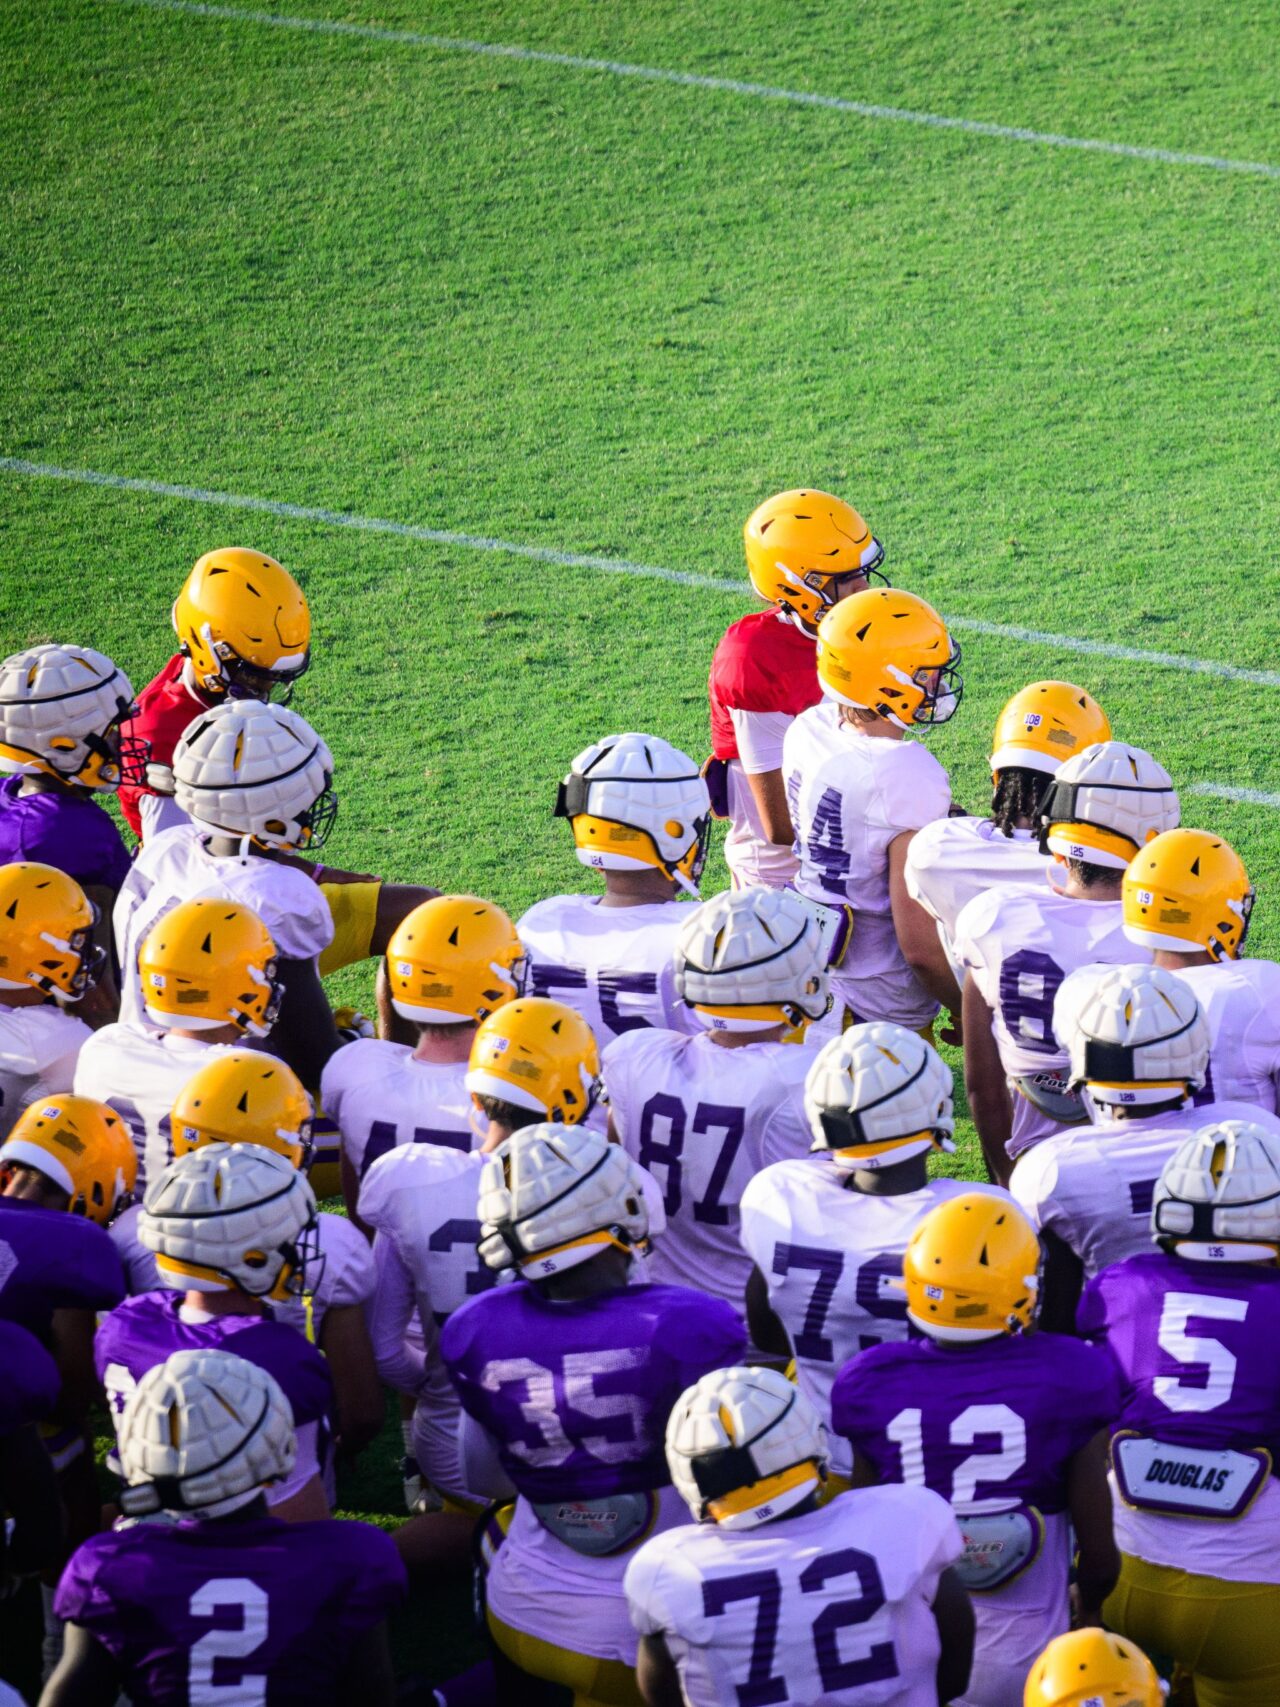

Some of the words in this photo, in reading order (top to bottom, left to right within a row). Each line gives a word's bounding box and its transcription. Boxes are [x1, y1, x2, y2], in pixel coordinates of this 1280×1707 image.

[1026, 714, 1041, 726] 108
[1069, 845, 1084, 858] 125
[639, 1092, 746, 1225] 87
[480, 1346, 651, 1469] 35
[1153, 1291, 1249, 1413] 5
[886, 1403, 1027, 1517] 12
[1145, 1459, 1230, 1492] DOUGLAS
[187, 1578, 269, 1707] 2
[701, 1548, 900, 1707] 72
